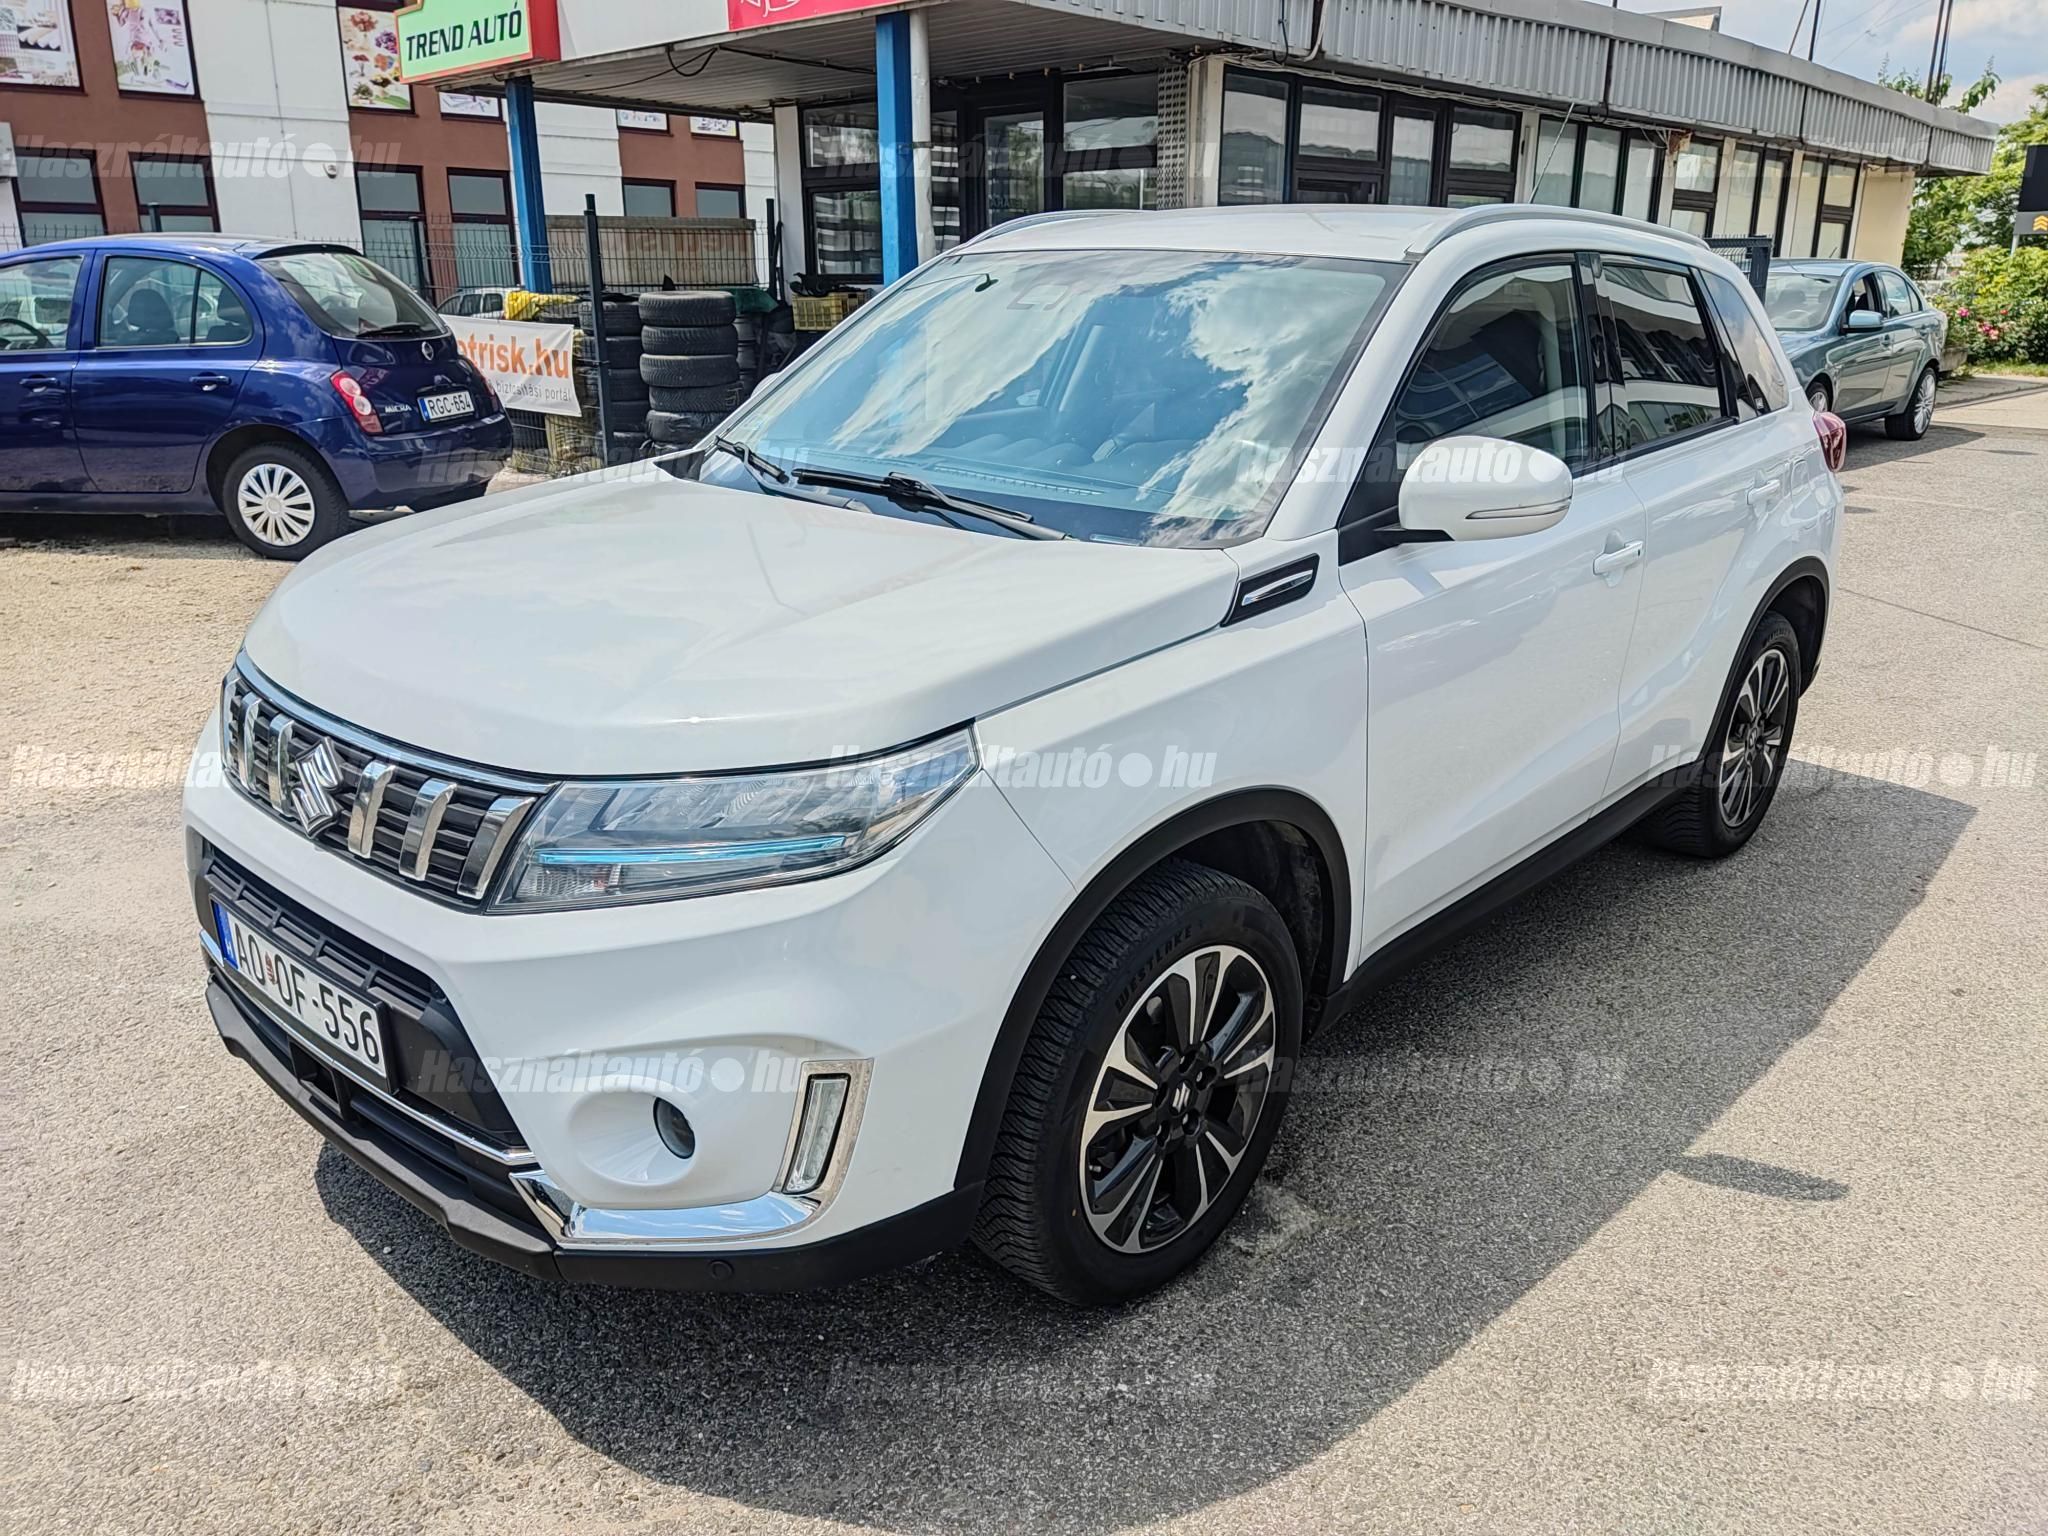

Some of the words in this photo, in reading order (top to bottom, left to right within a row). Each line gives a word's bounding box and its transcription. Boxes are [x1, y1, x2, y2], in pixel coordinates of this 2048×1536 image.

[405, 24, 464, 62] TREND
[468, 1, 522, 48] AUTÓ
[427, 394, 471, 417] RGC-654
[274, 953, 380, 1065] OF-556
